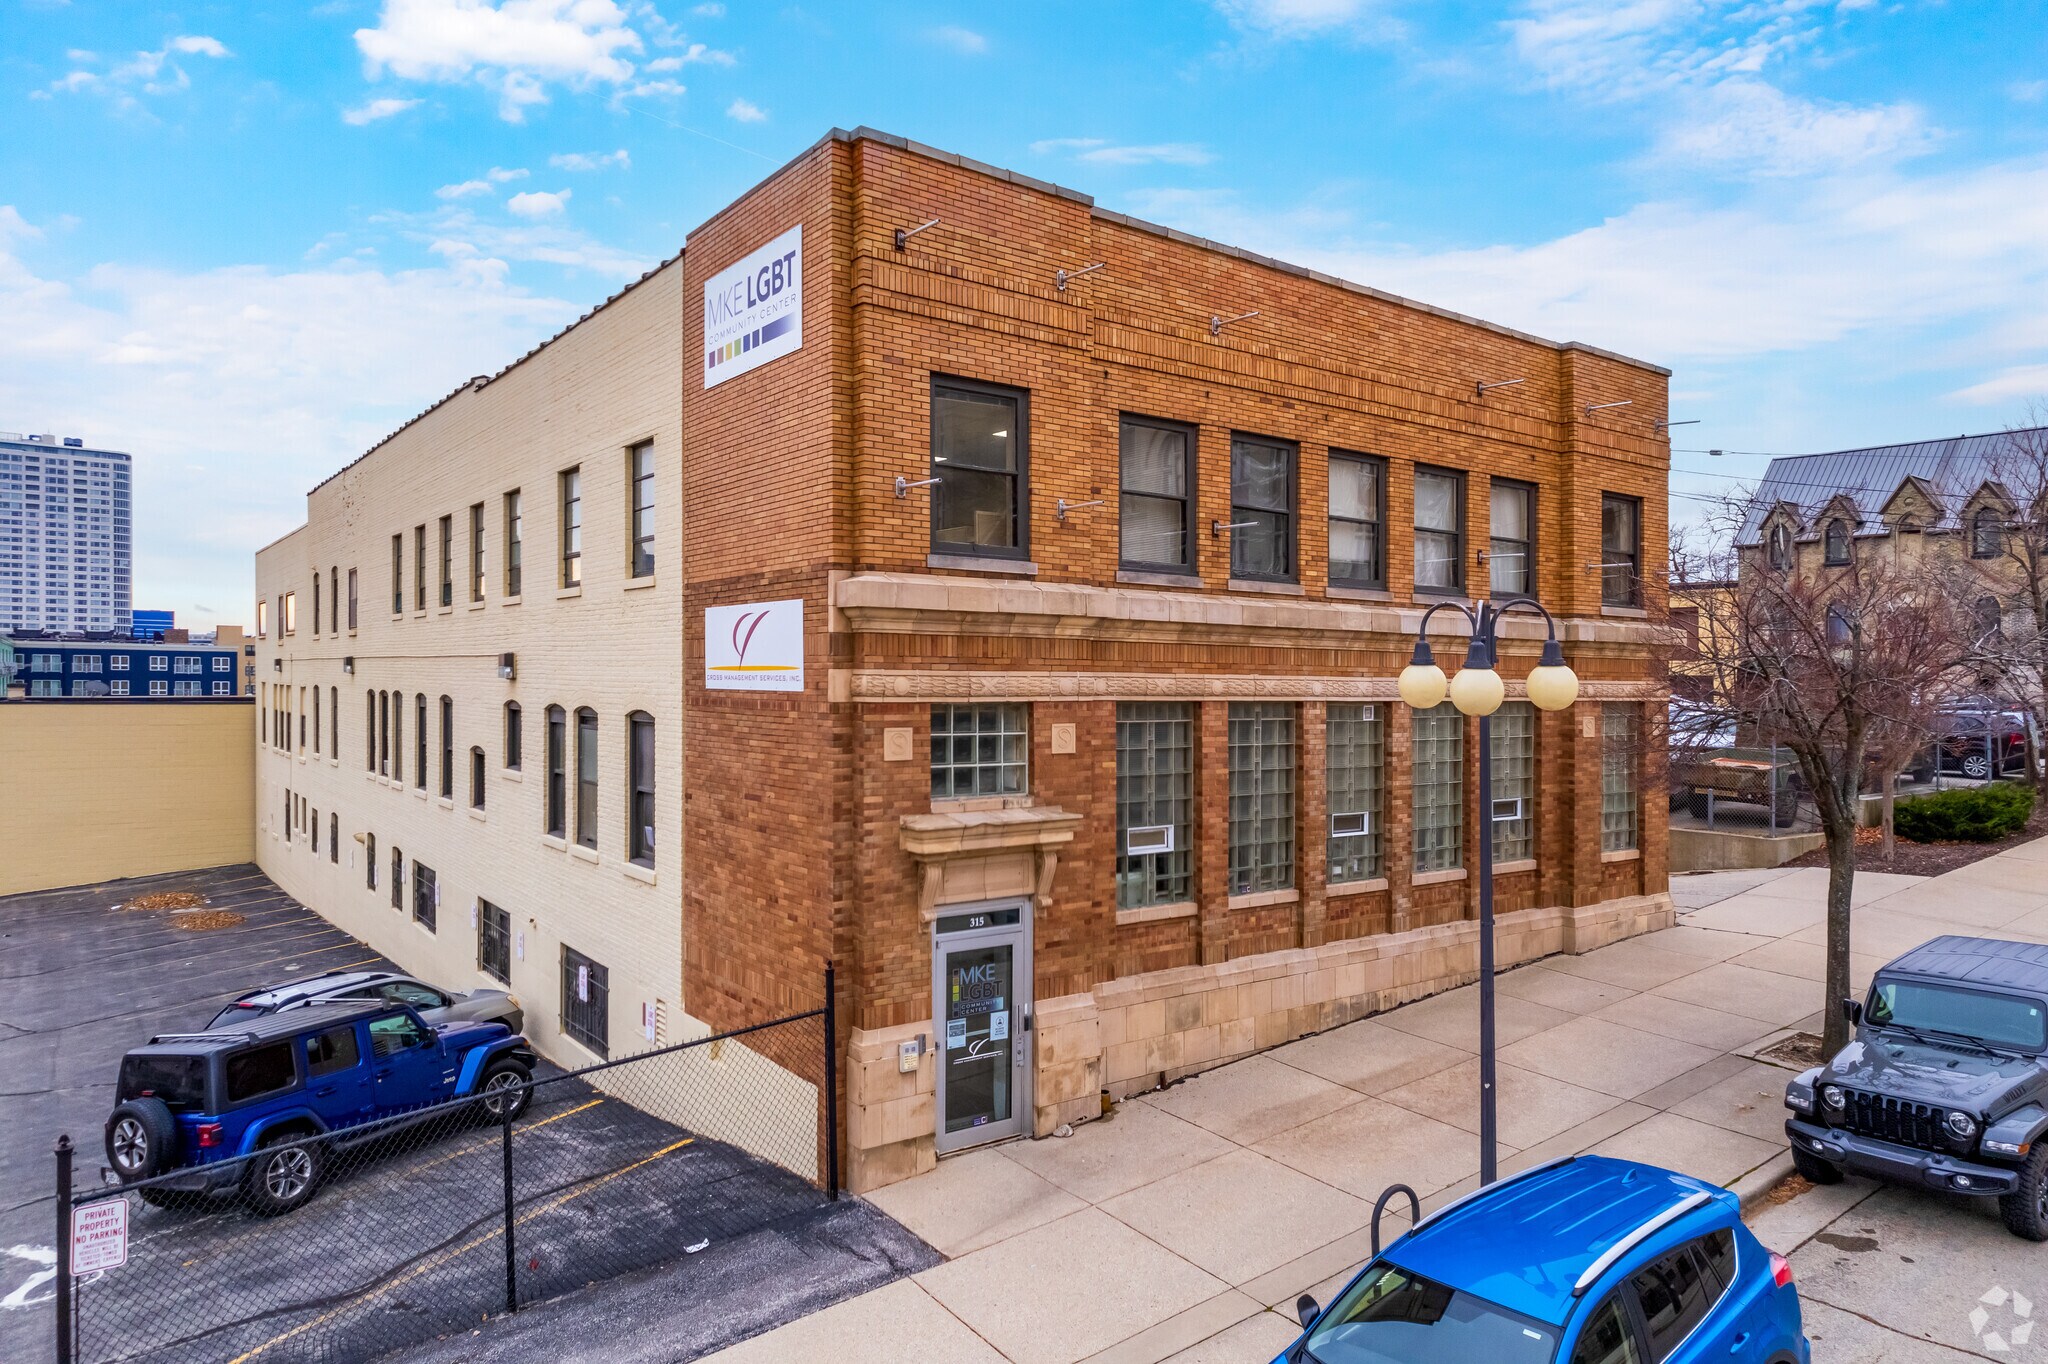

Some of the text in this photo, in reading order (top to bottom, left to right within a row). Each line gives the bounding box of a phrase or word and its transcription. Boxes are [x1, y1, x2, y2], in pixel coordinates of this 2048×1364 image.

[708, 249, 796, 330] MKE LGBT
[708, 293, 797, 345] COMMUNITY CENTER
[969, 916, 985, 928] 315
[960, 963, 995, 985] MKE
[961, 980, 1002, 1002] LGBT
[961, 1006, 987, 1015] CENTER
[84, 1207, 115, 1220] PRIVATE
[79, 1217, 120, 1232] PROPERTY
[75, 1227, 123, 1245] NO PARKING
